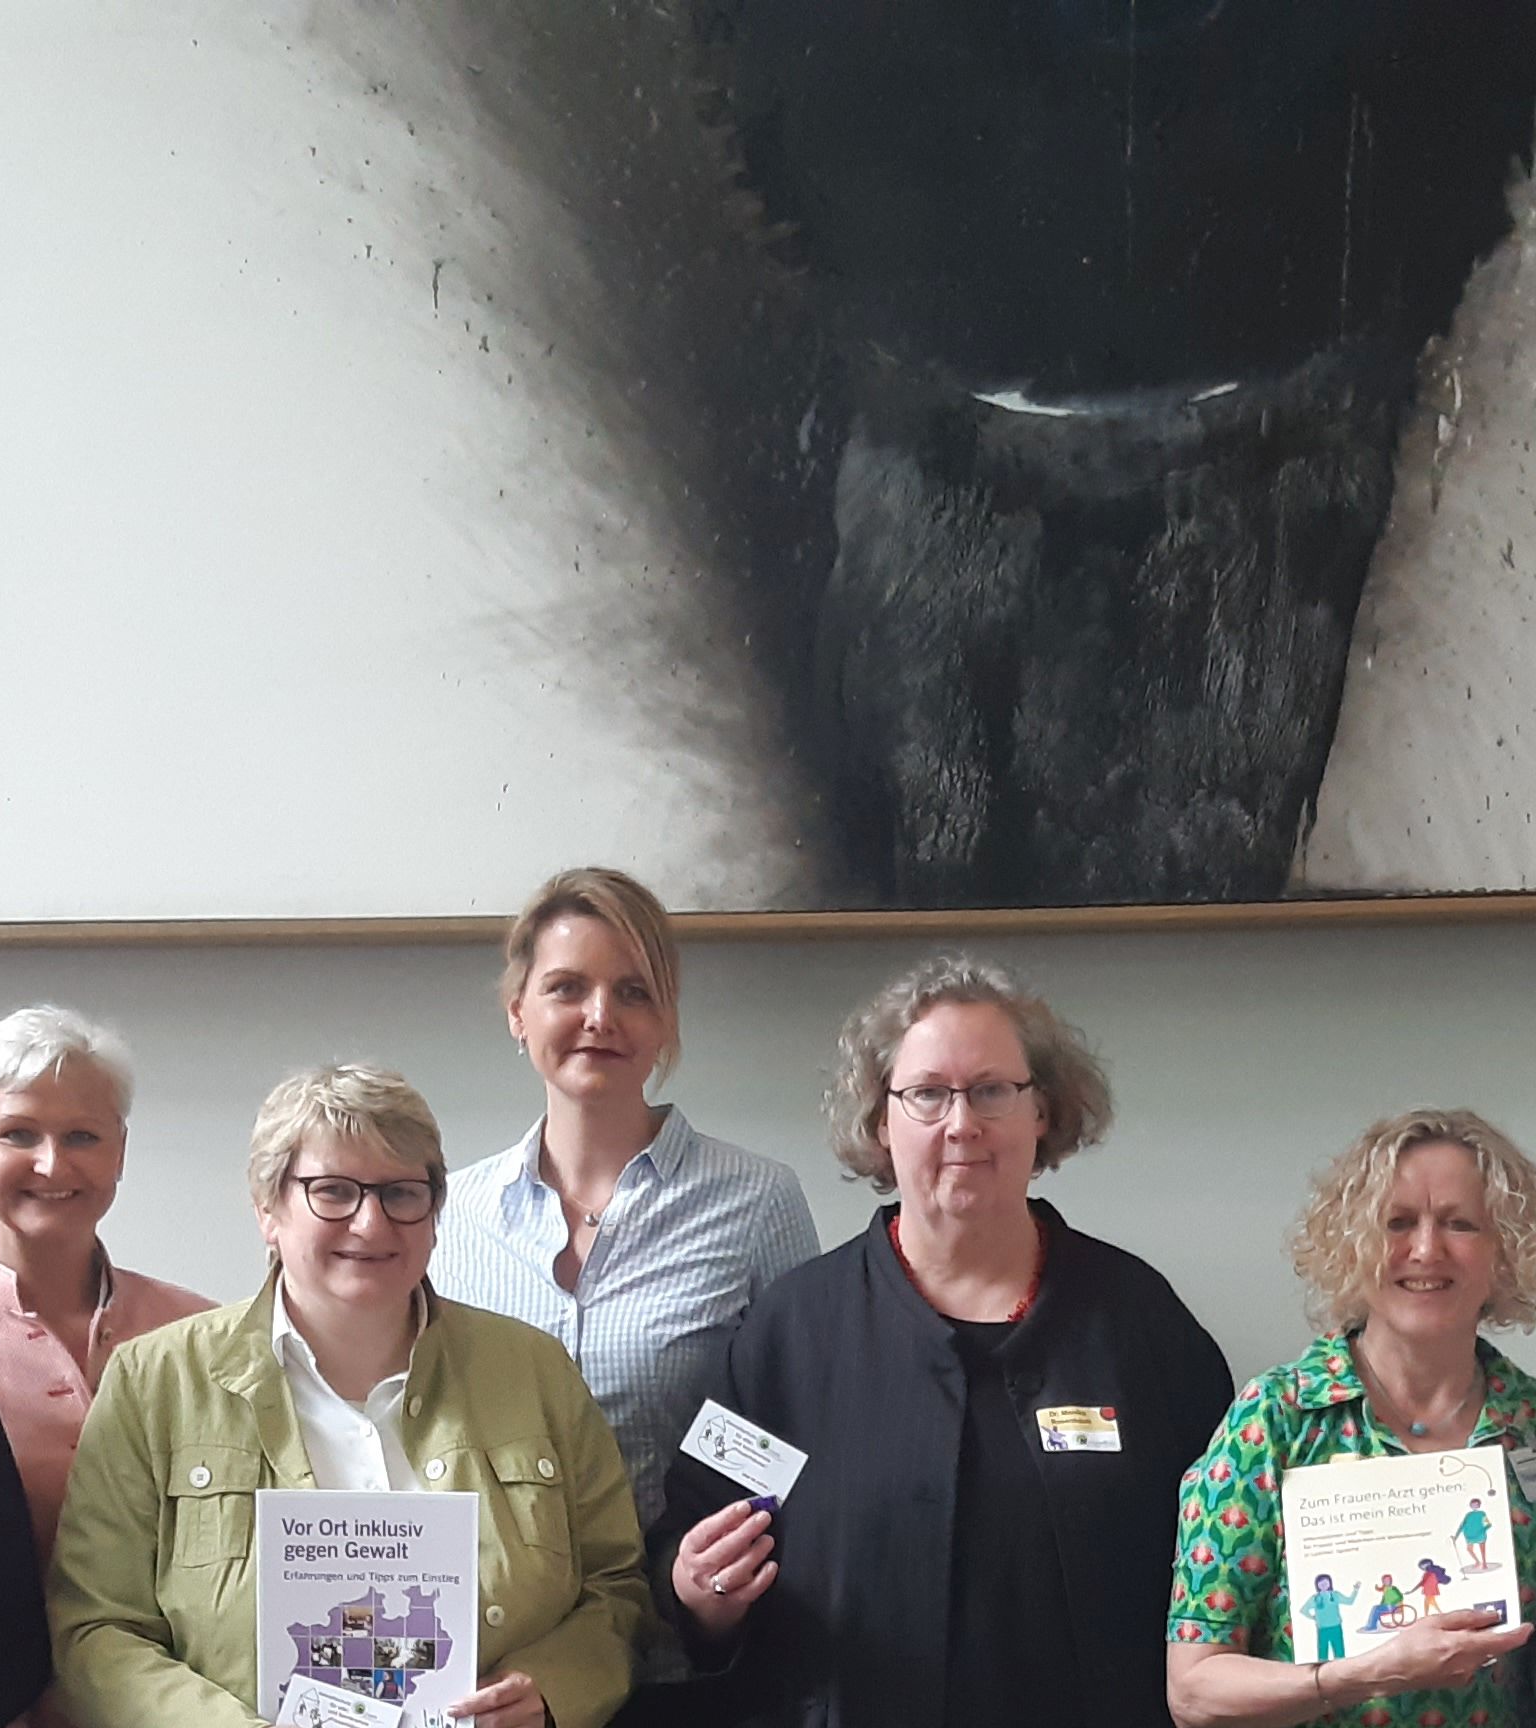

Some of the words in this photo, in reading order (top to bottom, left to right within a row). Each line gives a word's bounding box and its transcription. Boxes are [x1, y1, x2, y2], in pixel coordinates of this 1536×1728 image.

[1299, 1498, 1330, 1510] Zum
[1334, 1488, 1415, 1505] Frauen-Arzt
[1300, 1515, 1326, 1528] Das
[1329, 1513, 1345, 1524] ist
[1349, 1508, 1384, 1521] mein
[1388, 1503, 1427, 1517] Recht
[281, 1518, 313, 1536] Vor
[319, 1519, 348, 1536] Ort
[354, 1519, 424, 1537] inklusiv
[284, 1544, 339, 1562] gegen
[345, 1541, 409, 1559] Gewalt
[283, 1570, 344, 1583] Erfahrungen
[347, 1572, 365, 1581] und
[368, 1571, 395, 1583] Tipps
[398, 1573, 418, 1582] zum
[422, 1572, 460, 1585] Einstieg
